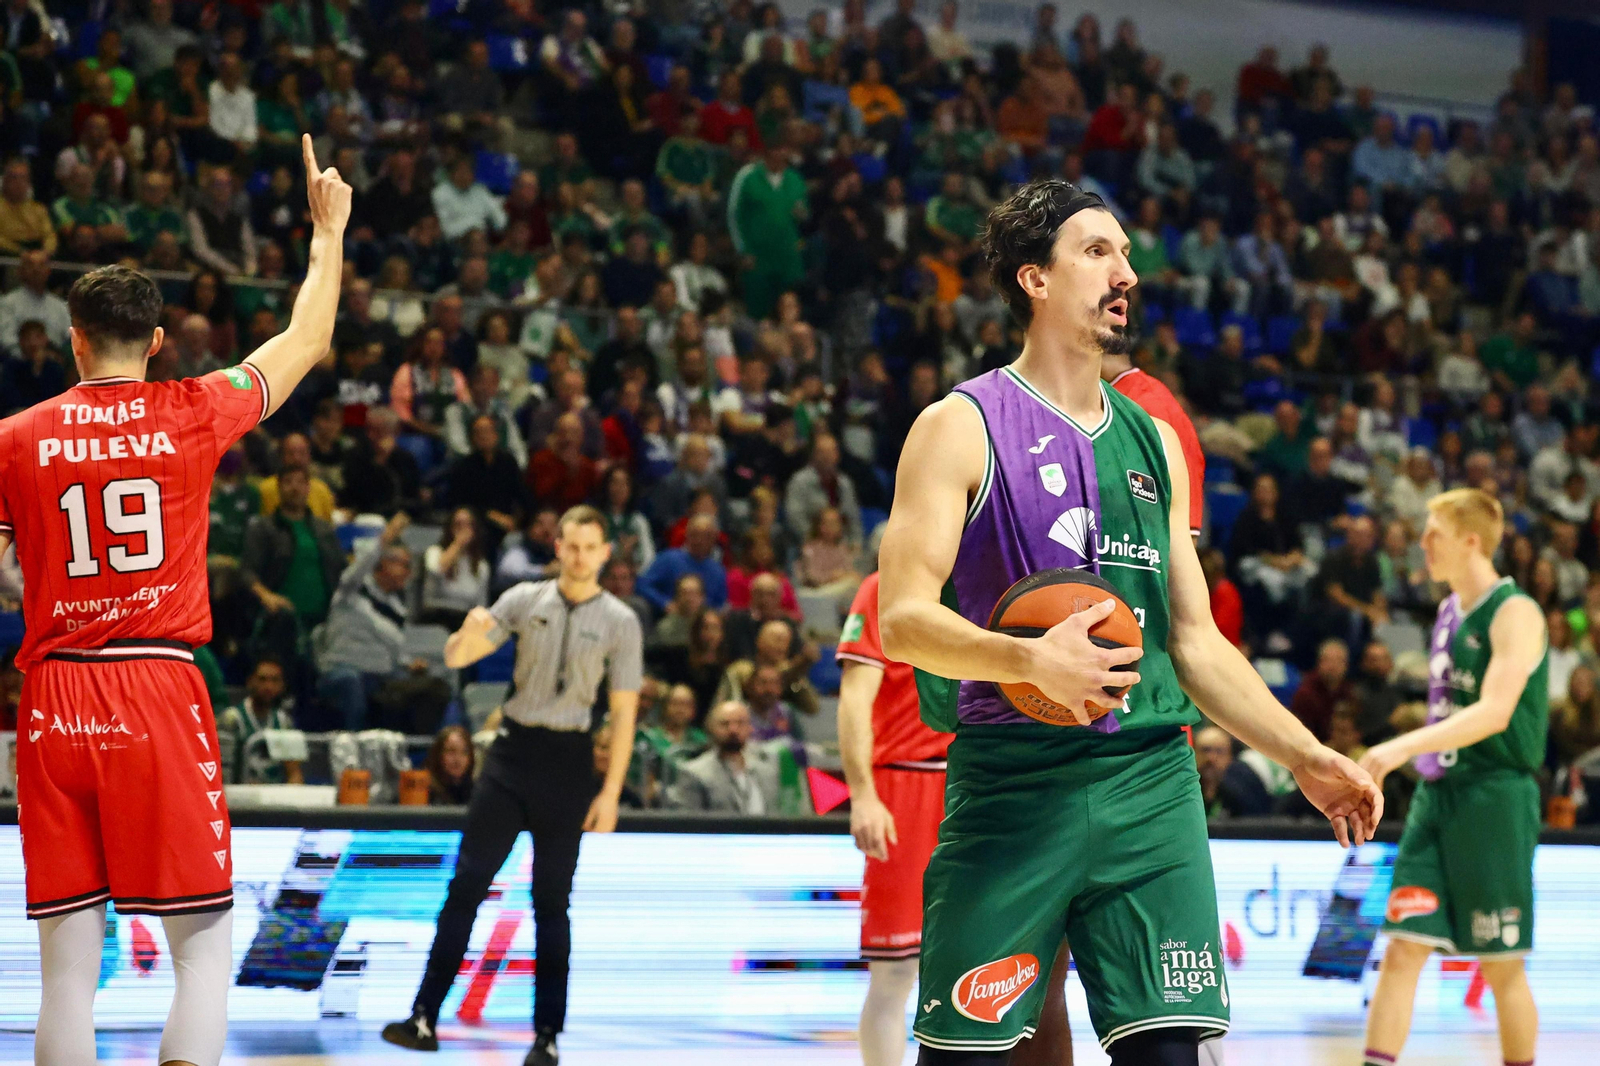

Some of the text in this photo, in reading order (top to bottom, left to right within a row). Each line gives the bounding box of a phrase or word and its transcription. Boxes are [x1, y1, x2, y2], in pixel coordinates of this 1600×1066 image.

[38, 431, 177, 467] PULEVA
[59, 476, 165, 579] 19
[50, 713, 133, 736] Andalucía
[1160, 938, 1188, 950] sabor
[1160, 942, 1217, 969] a má
[961, 960, 1036, 1008] famadesa
[1161, 963, 1219, 994] laga
